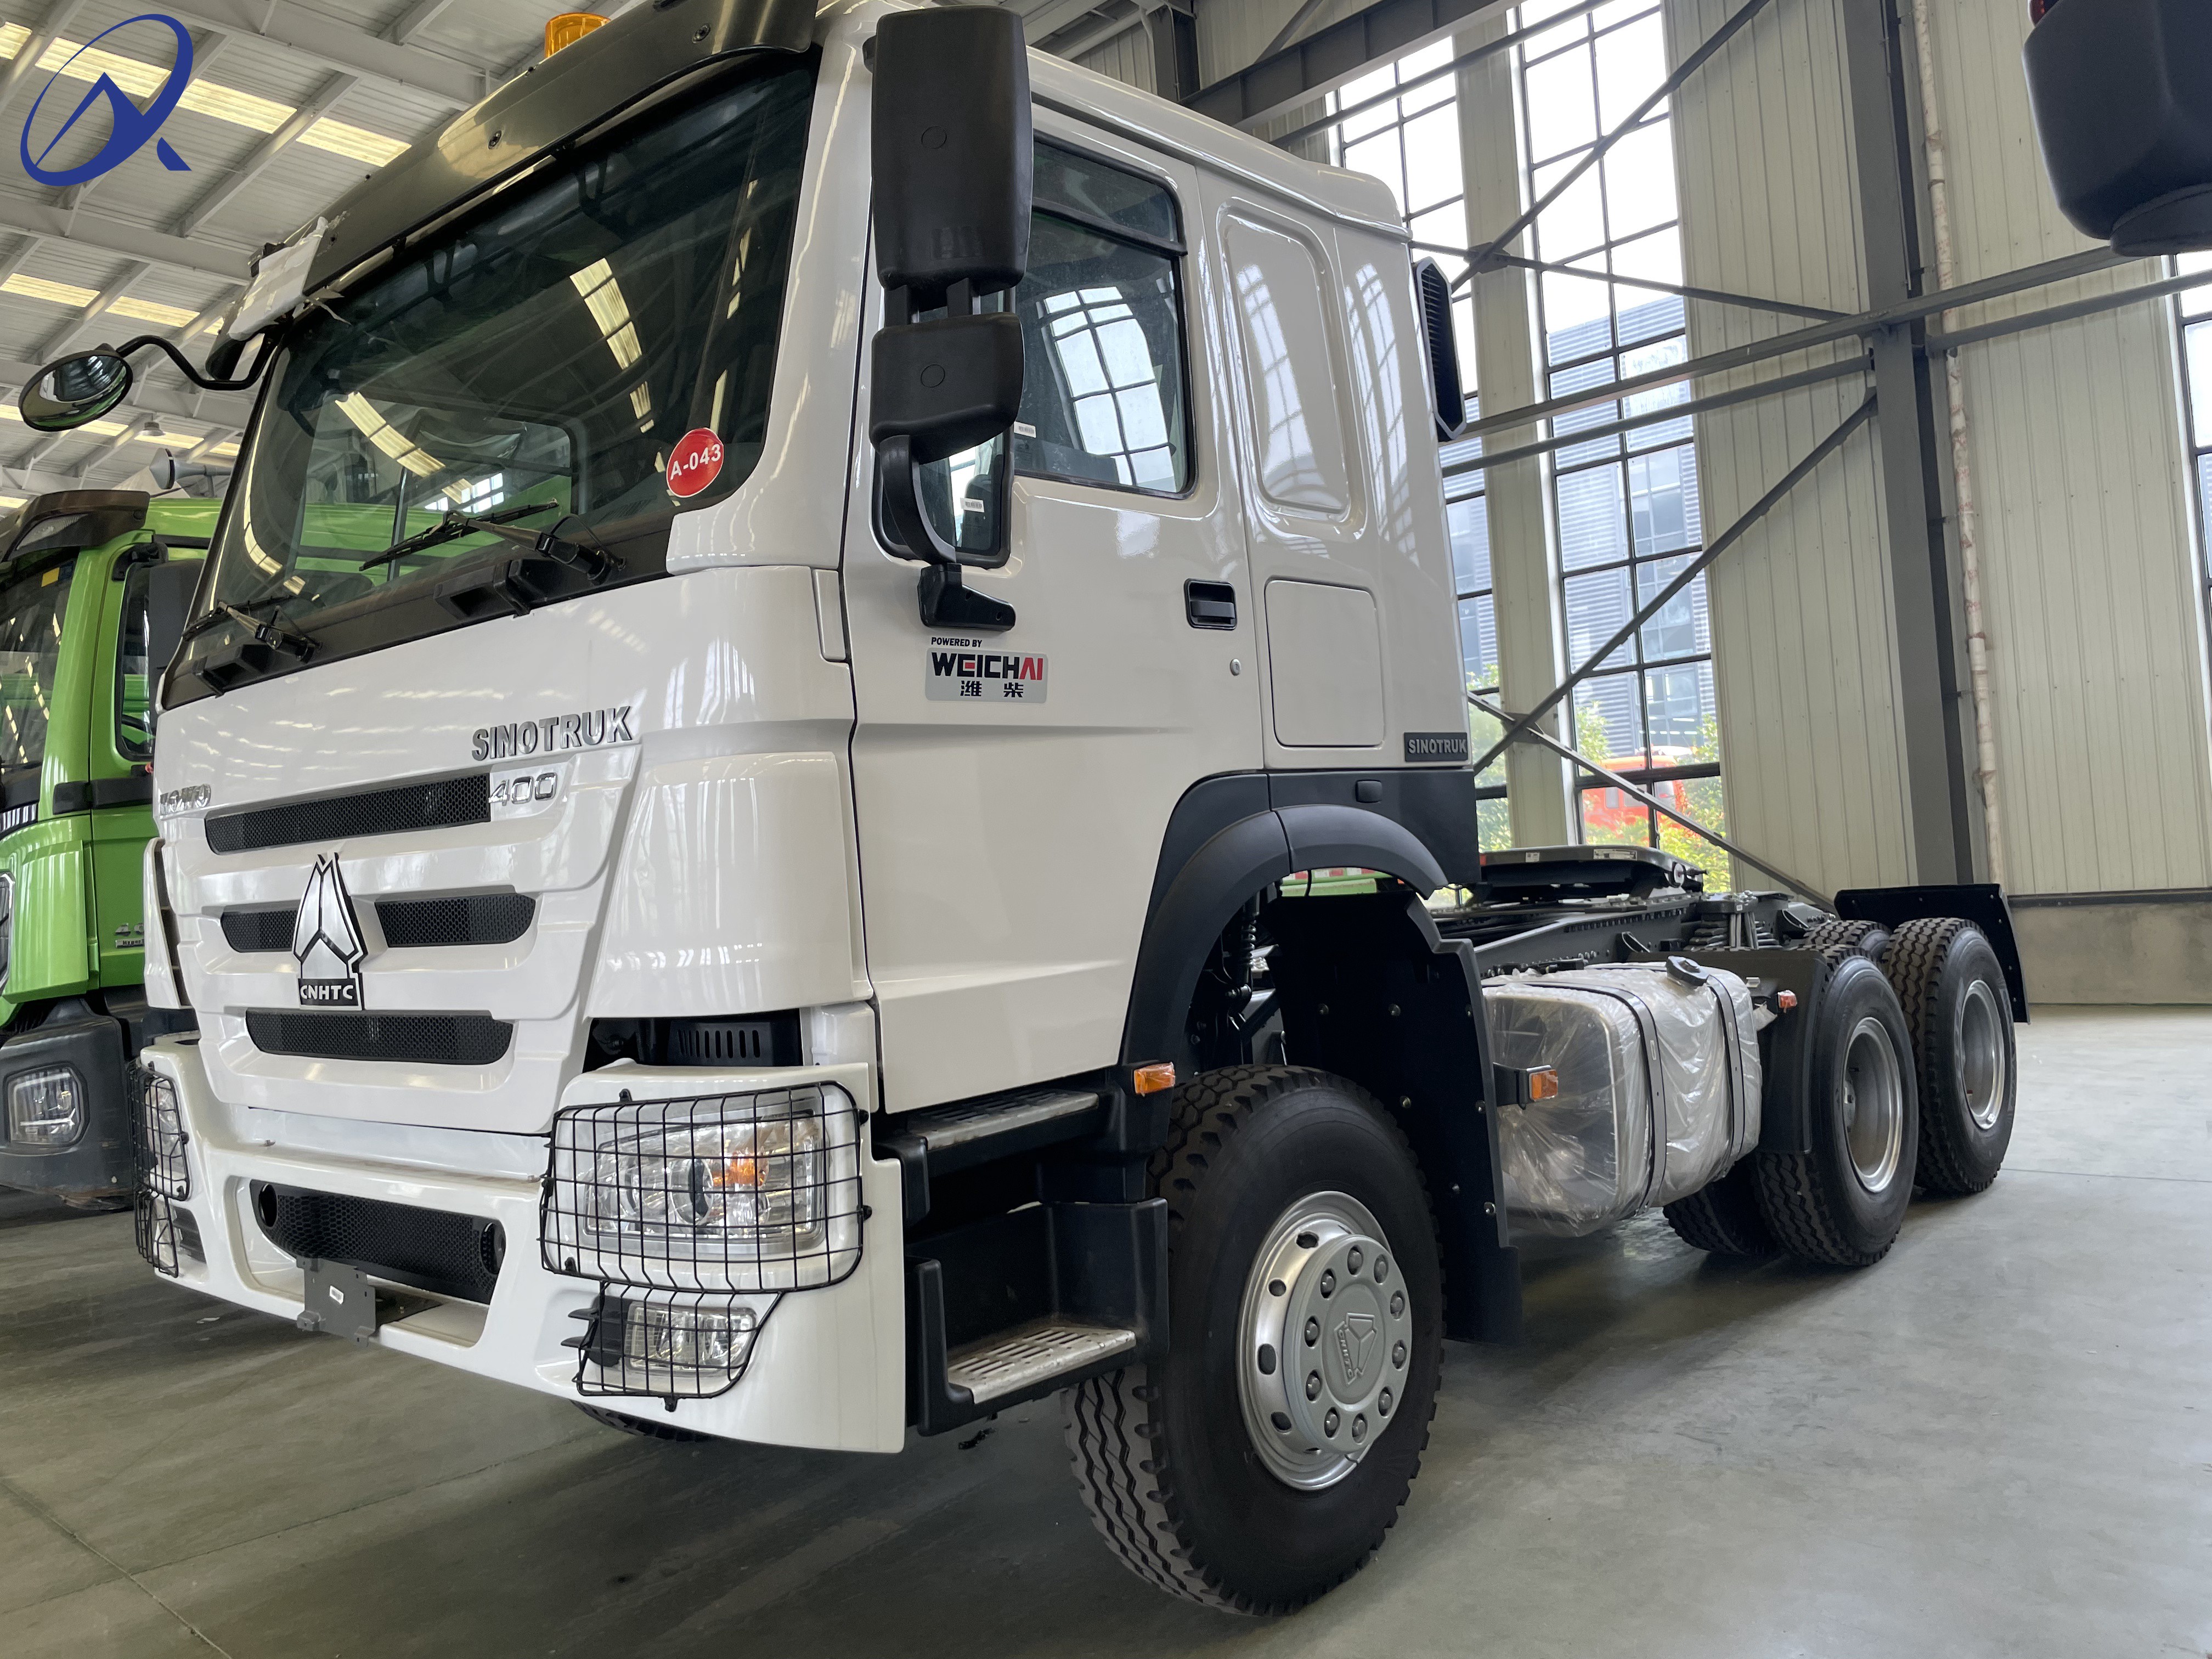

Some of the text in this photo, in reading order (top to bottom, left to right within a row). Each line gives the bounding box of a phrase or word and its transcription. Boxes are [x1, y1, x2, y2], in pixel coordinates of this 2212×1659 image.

[670, 444, 721, 481] A-043
[931, 637, 983, 648] POWERED BY
[931, 652, 1043, 681] WEICHAI
[471, 705, 632, 761] SINOTRUK
[1408, 738, 1468, 754] SINOTRUK
[488, 772, 558, 806] 400
[300, 984, 354, 1000] CNHTC
